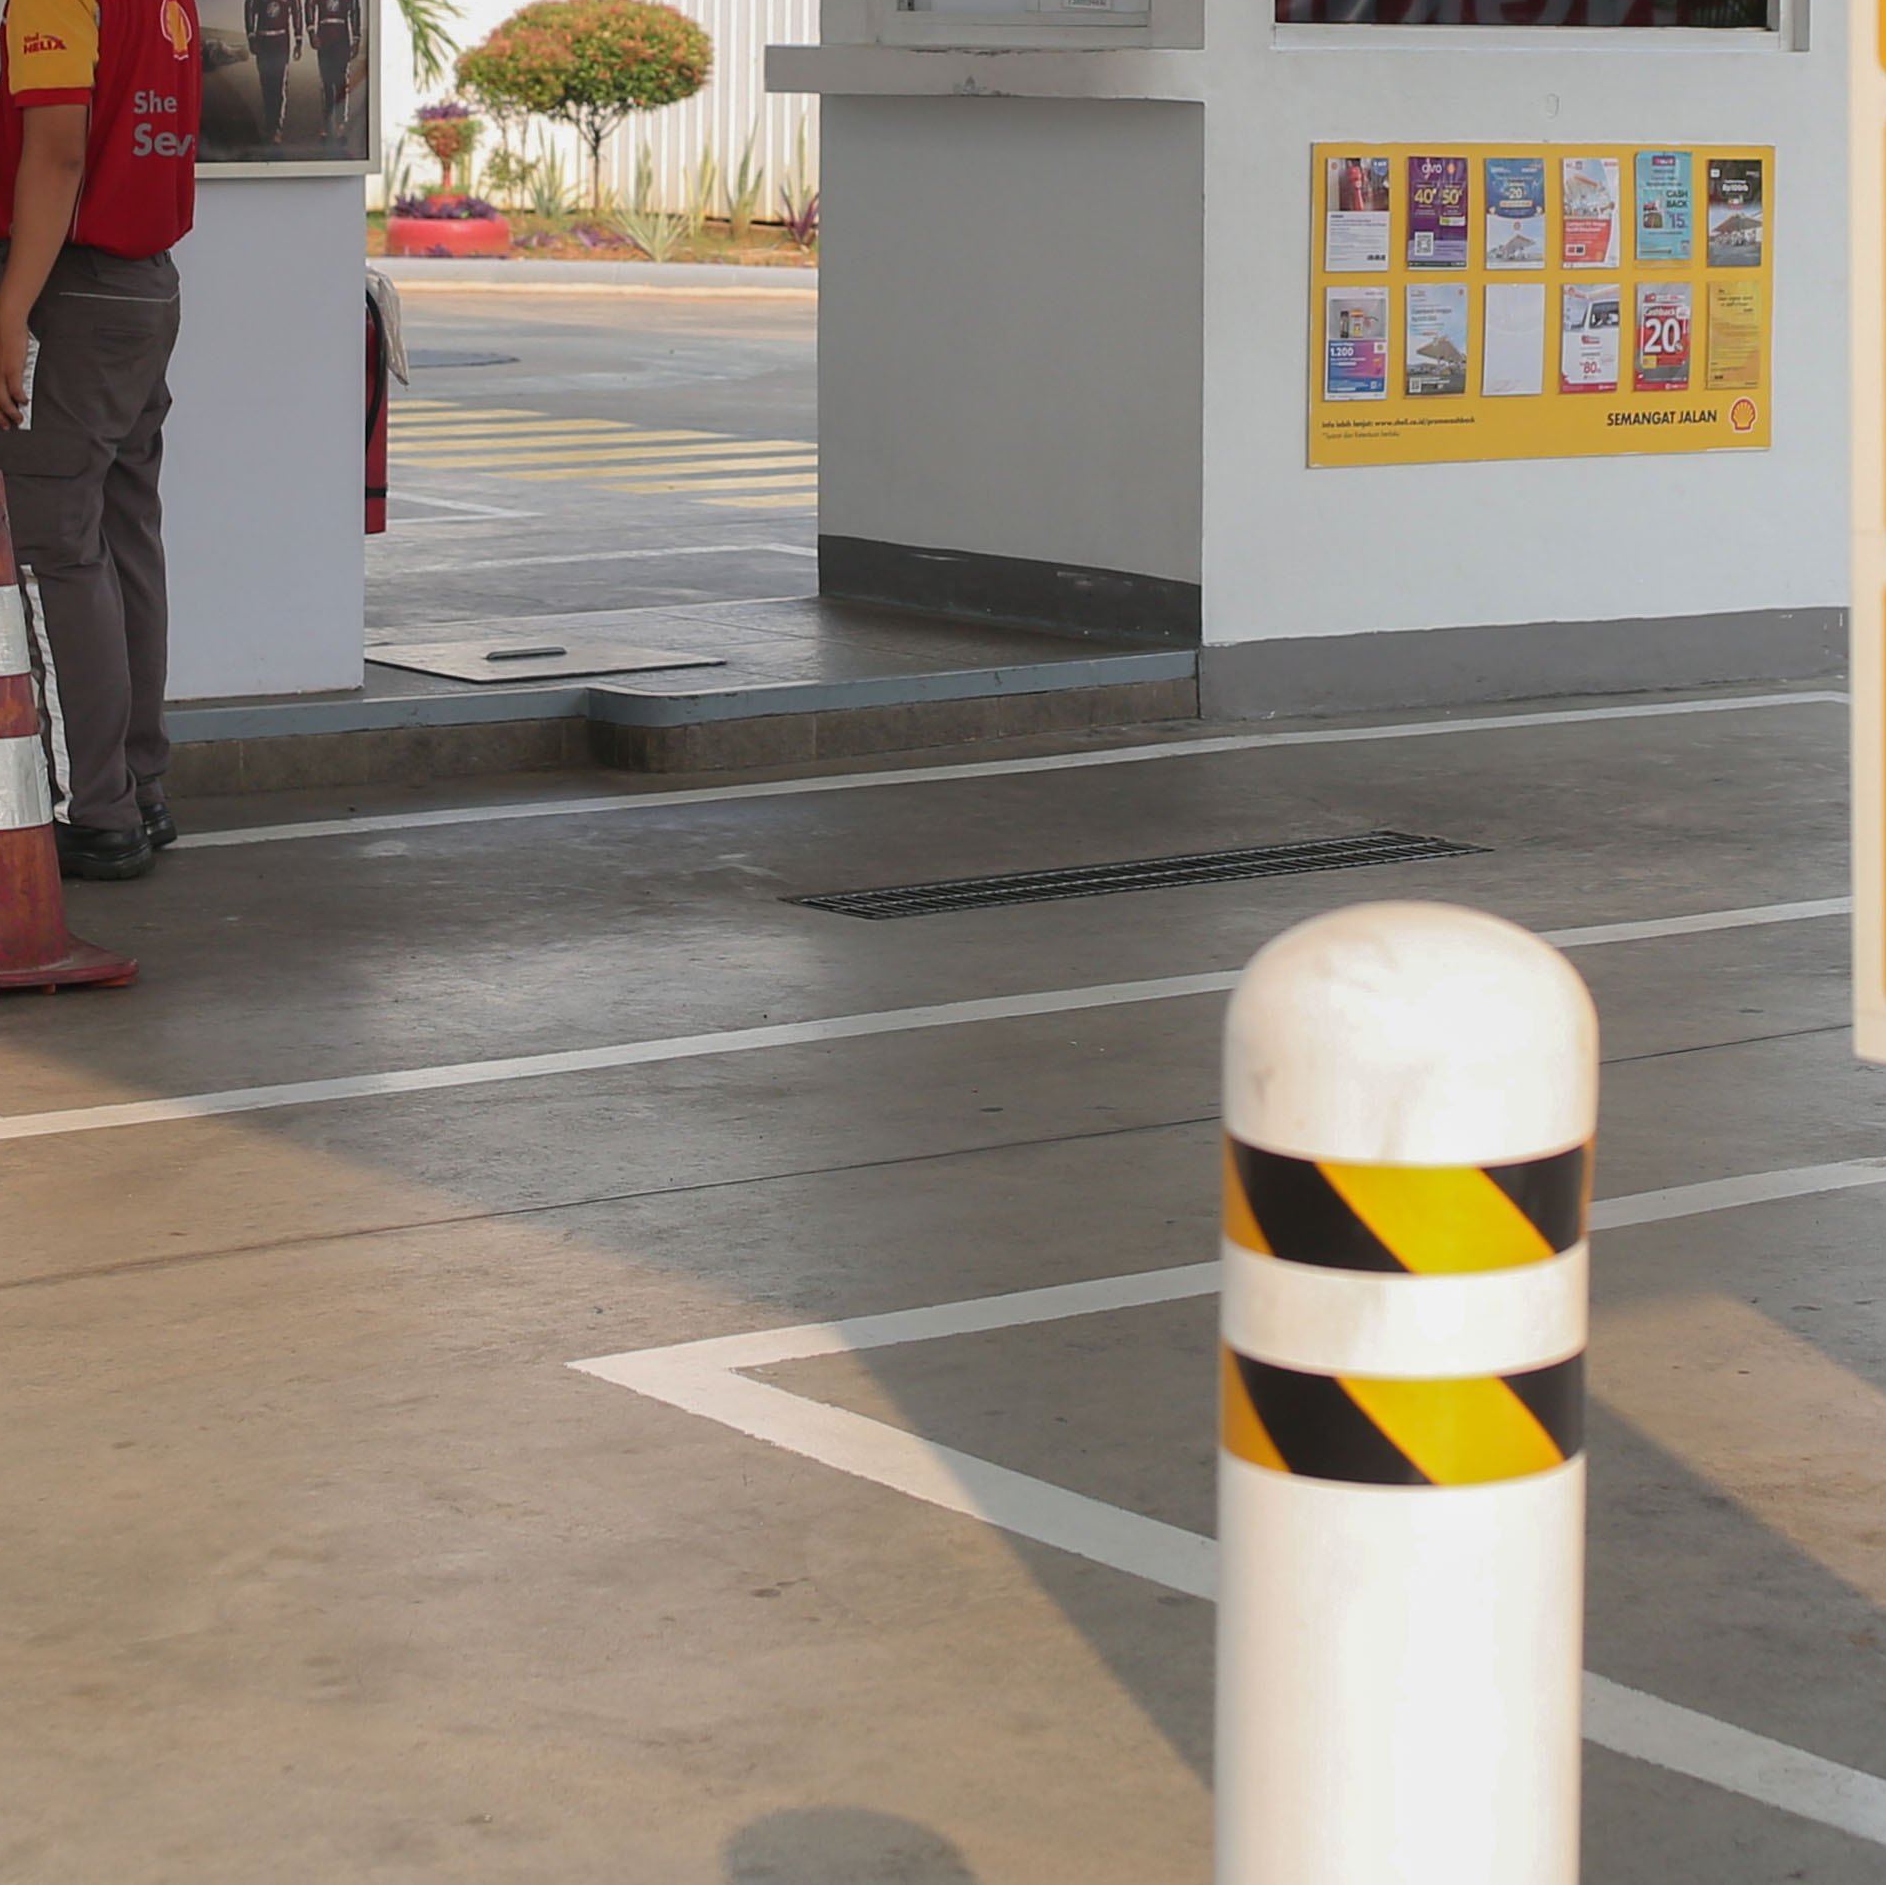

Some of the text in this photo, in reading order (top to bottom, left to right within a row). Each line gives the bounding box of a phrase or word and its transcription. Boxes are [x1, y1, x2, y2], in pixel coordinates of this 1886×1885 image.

[23, 36, 67, 54] HELIX
[133, 90, 177, 113] She
[132, 123, 195, 156] Ser
[1607, 410, 1717, 426] SEMANGAT JALAN
